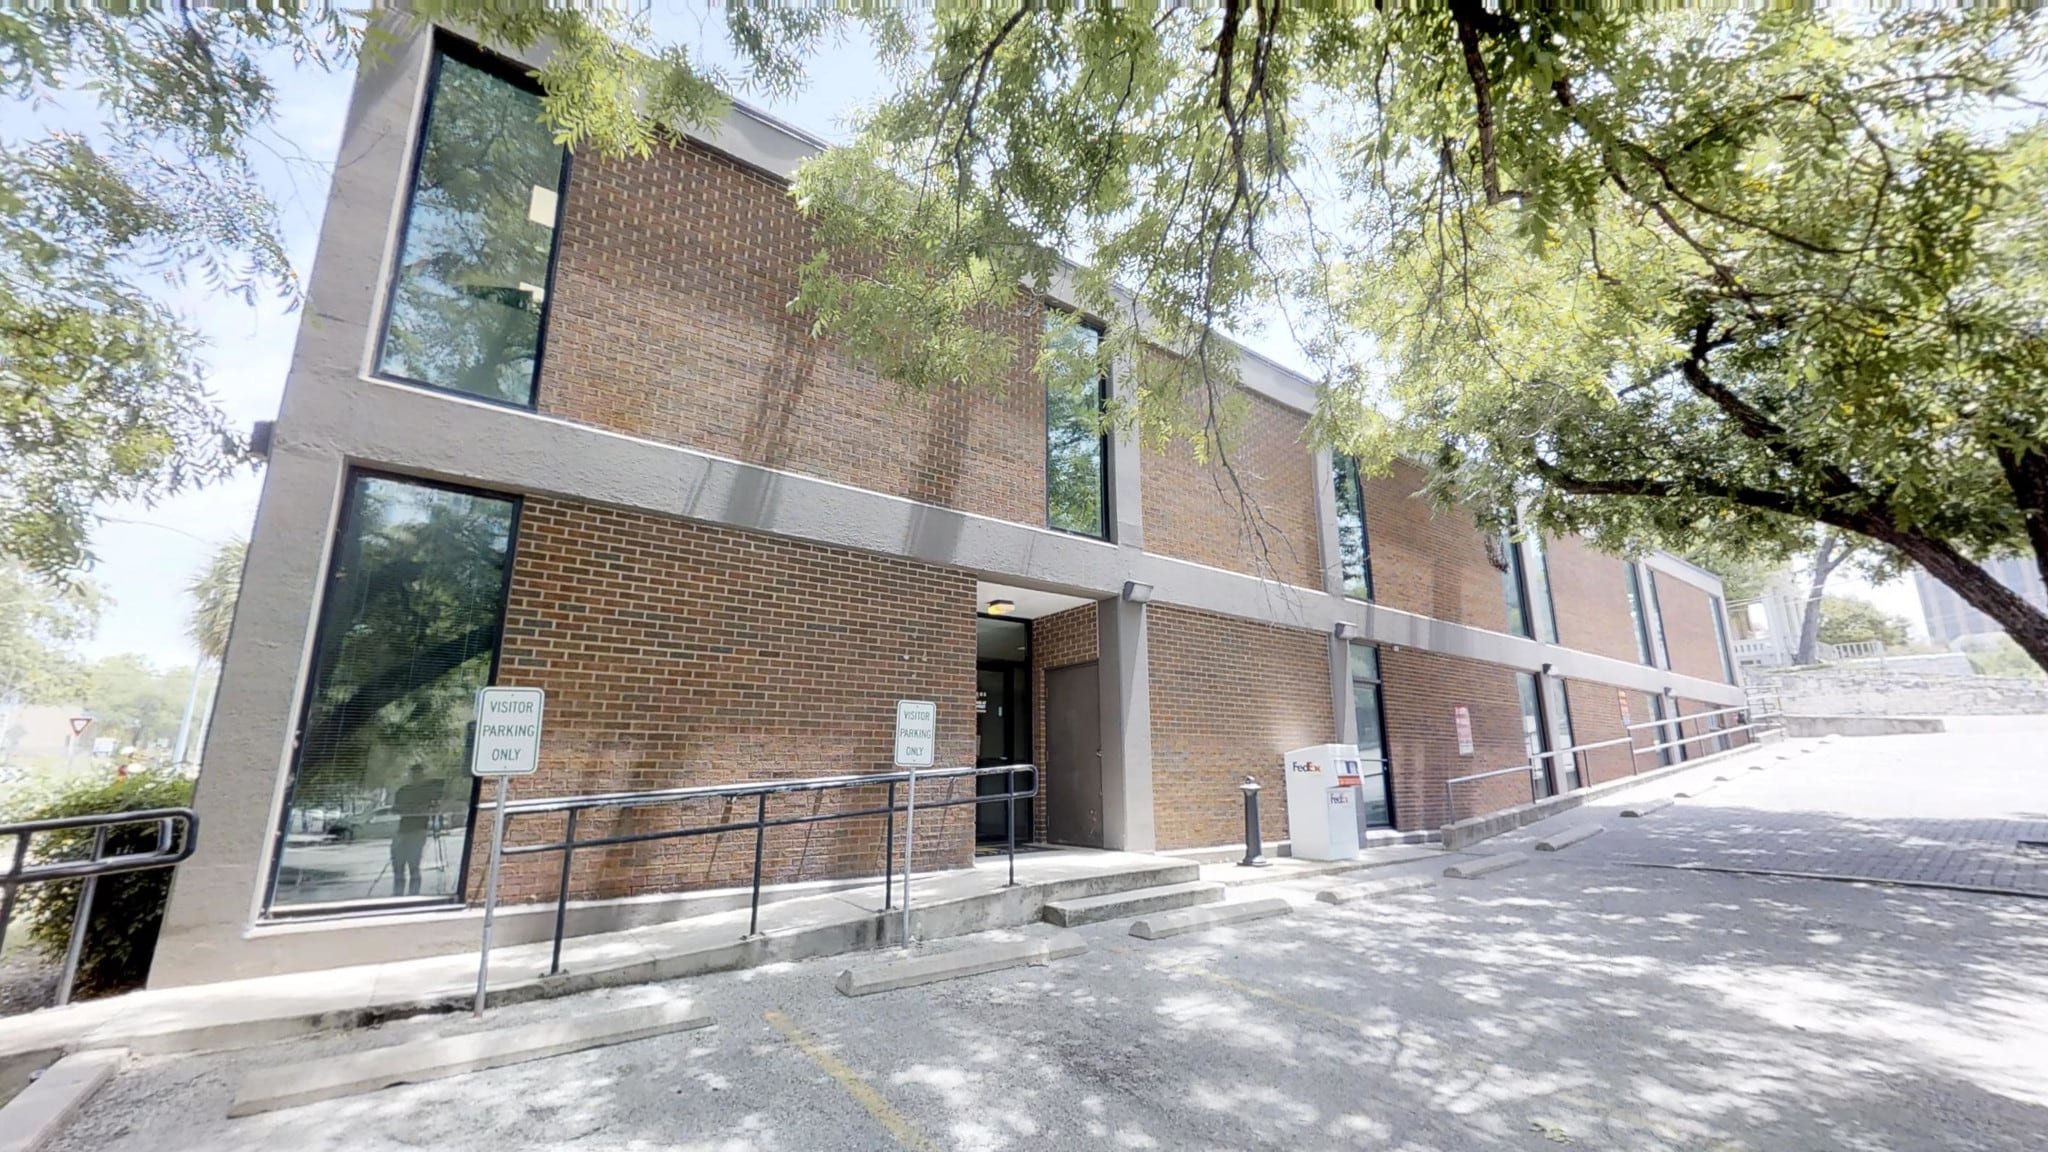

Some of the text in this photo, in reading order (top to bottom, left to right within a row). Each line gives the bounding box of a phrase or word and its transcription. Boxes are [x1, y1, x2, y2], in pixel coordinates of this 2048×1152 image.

[490, 701, 534, 713] VISITOR
[903, 711, 930, 721] VISITOR
[482, 725, 535, 737] PARKING
[900, 728, 932, 739] PARKING
[491, 748, 521, 761] ONLY
[906, 746, 924, 757] ONLY
[1292, 761, 1321, 773] FedEx
